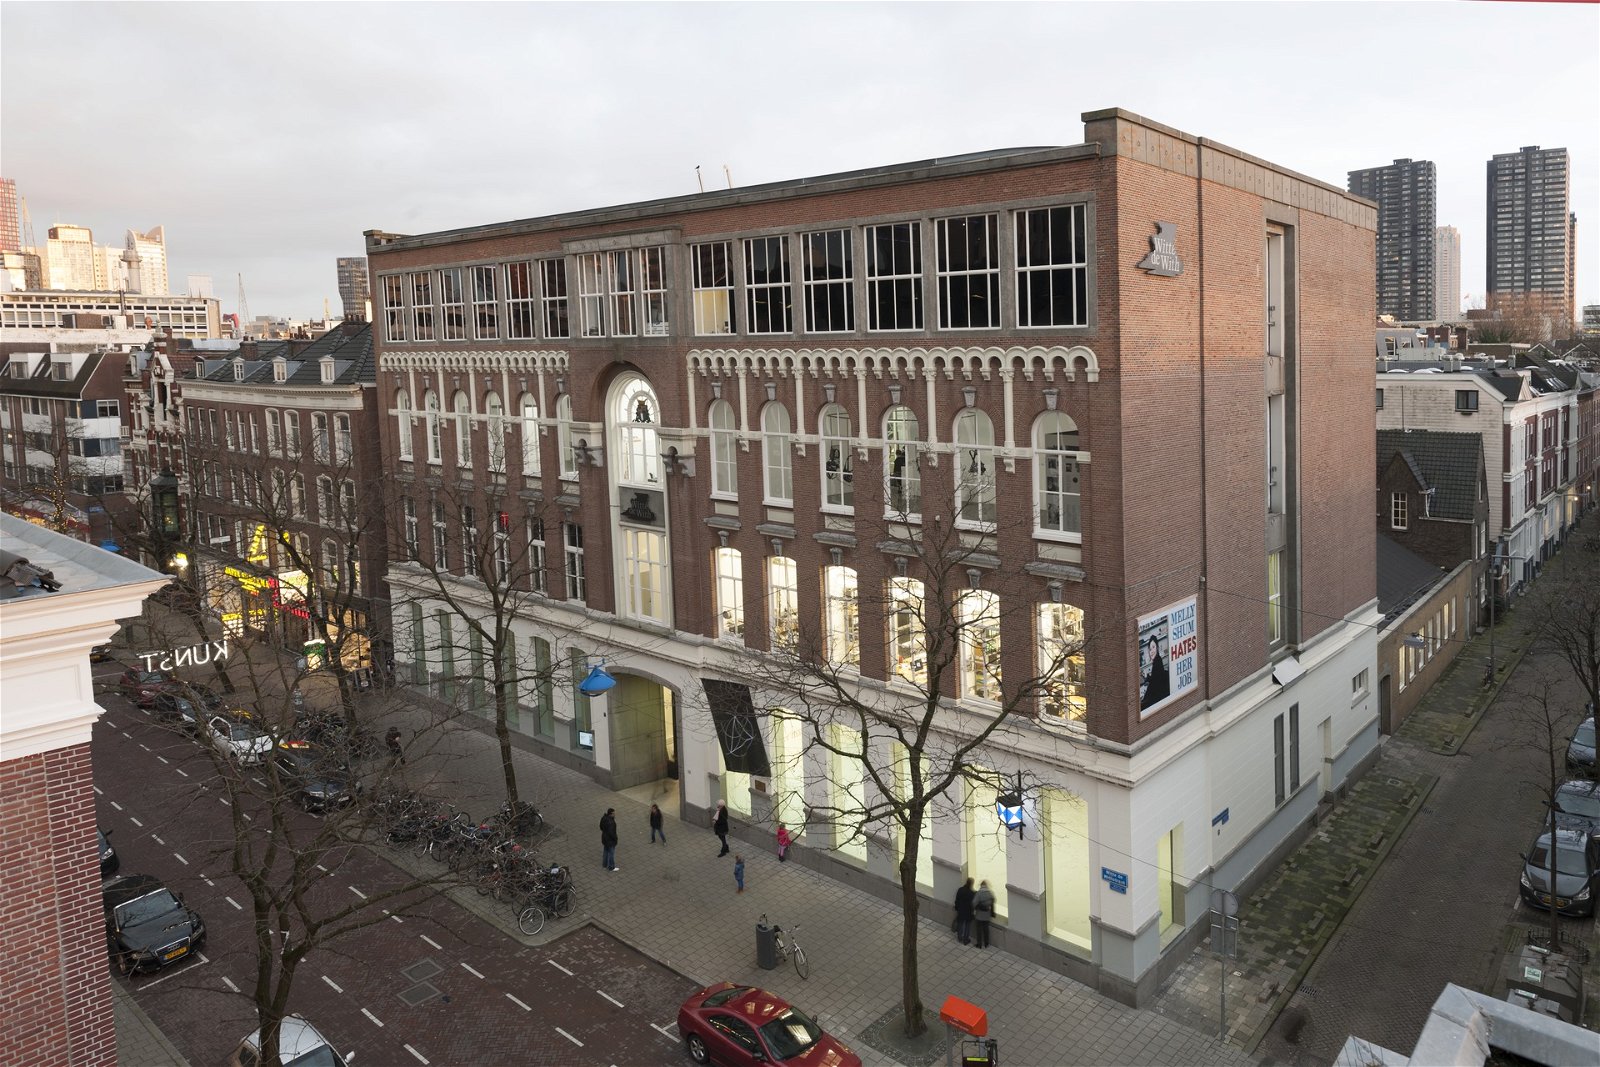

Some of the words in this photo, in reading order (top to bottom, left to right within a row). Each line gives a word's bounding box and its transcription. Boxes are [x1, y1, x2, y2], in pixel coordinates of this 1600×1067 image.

[1154, 238, 1176, 255] Witte
[1151, 251, 1160, 265] de
[1160, 255, 1180, 271] With
[1171, 604, 1196, 626] MELLY
[1173, 620, 1195, 641] SHUM
[1171, 636, 1197, 661] HATES
[1176, 657, 1193, 676] HER
[1177, 672, 1192, 690] JOB
